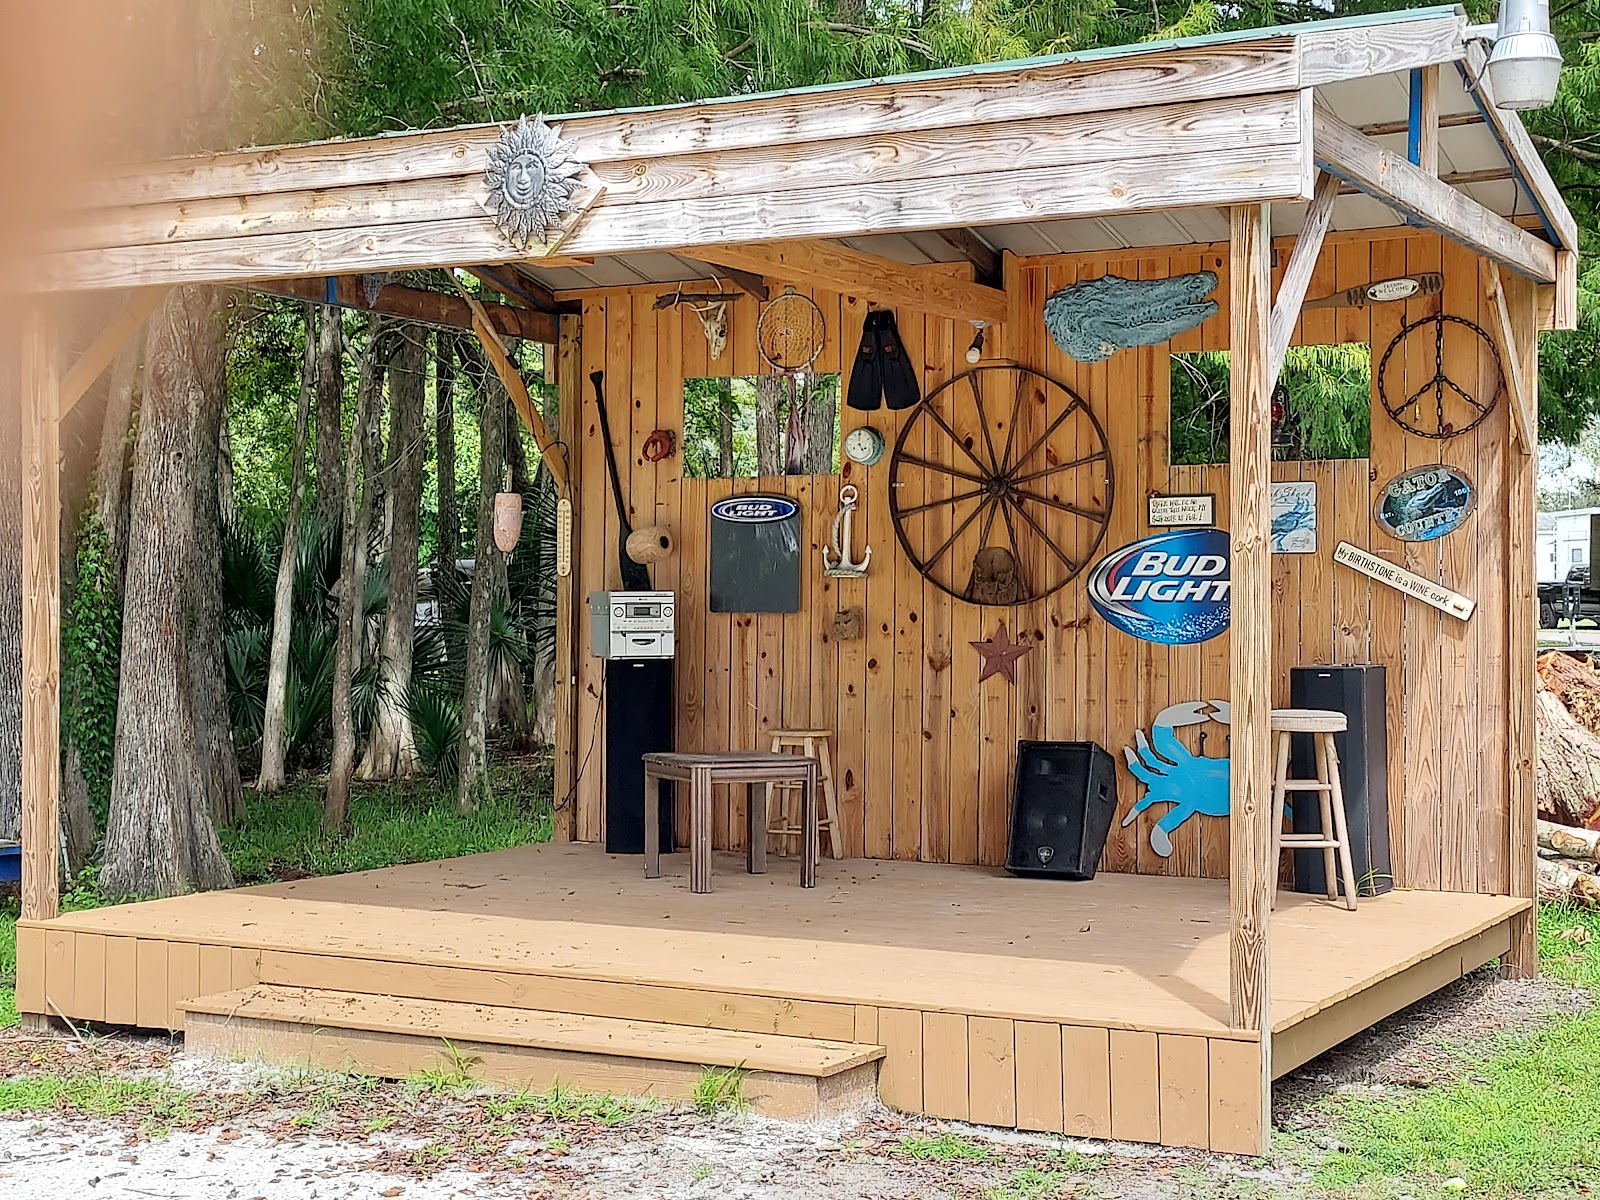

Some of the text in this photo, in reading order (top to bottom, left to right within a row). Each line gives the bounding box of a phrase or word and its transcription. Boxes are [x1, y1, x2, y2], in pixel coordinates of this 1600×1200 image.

[1388, 468, 1452, 498] GATOR
[1131, 551, 1227, 577] BUD
[1337, 547, 1450, 606] My BIRTHSTONE is a WINE cork
[1110, 576, 1231, 602] LIGHT
